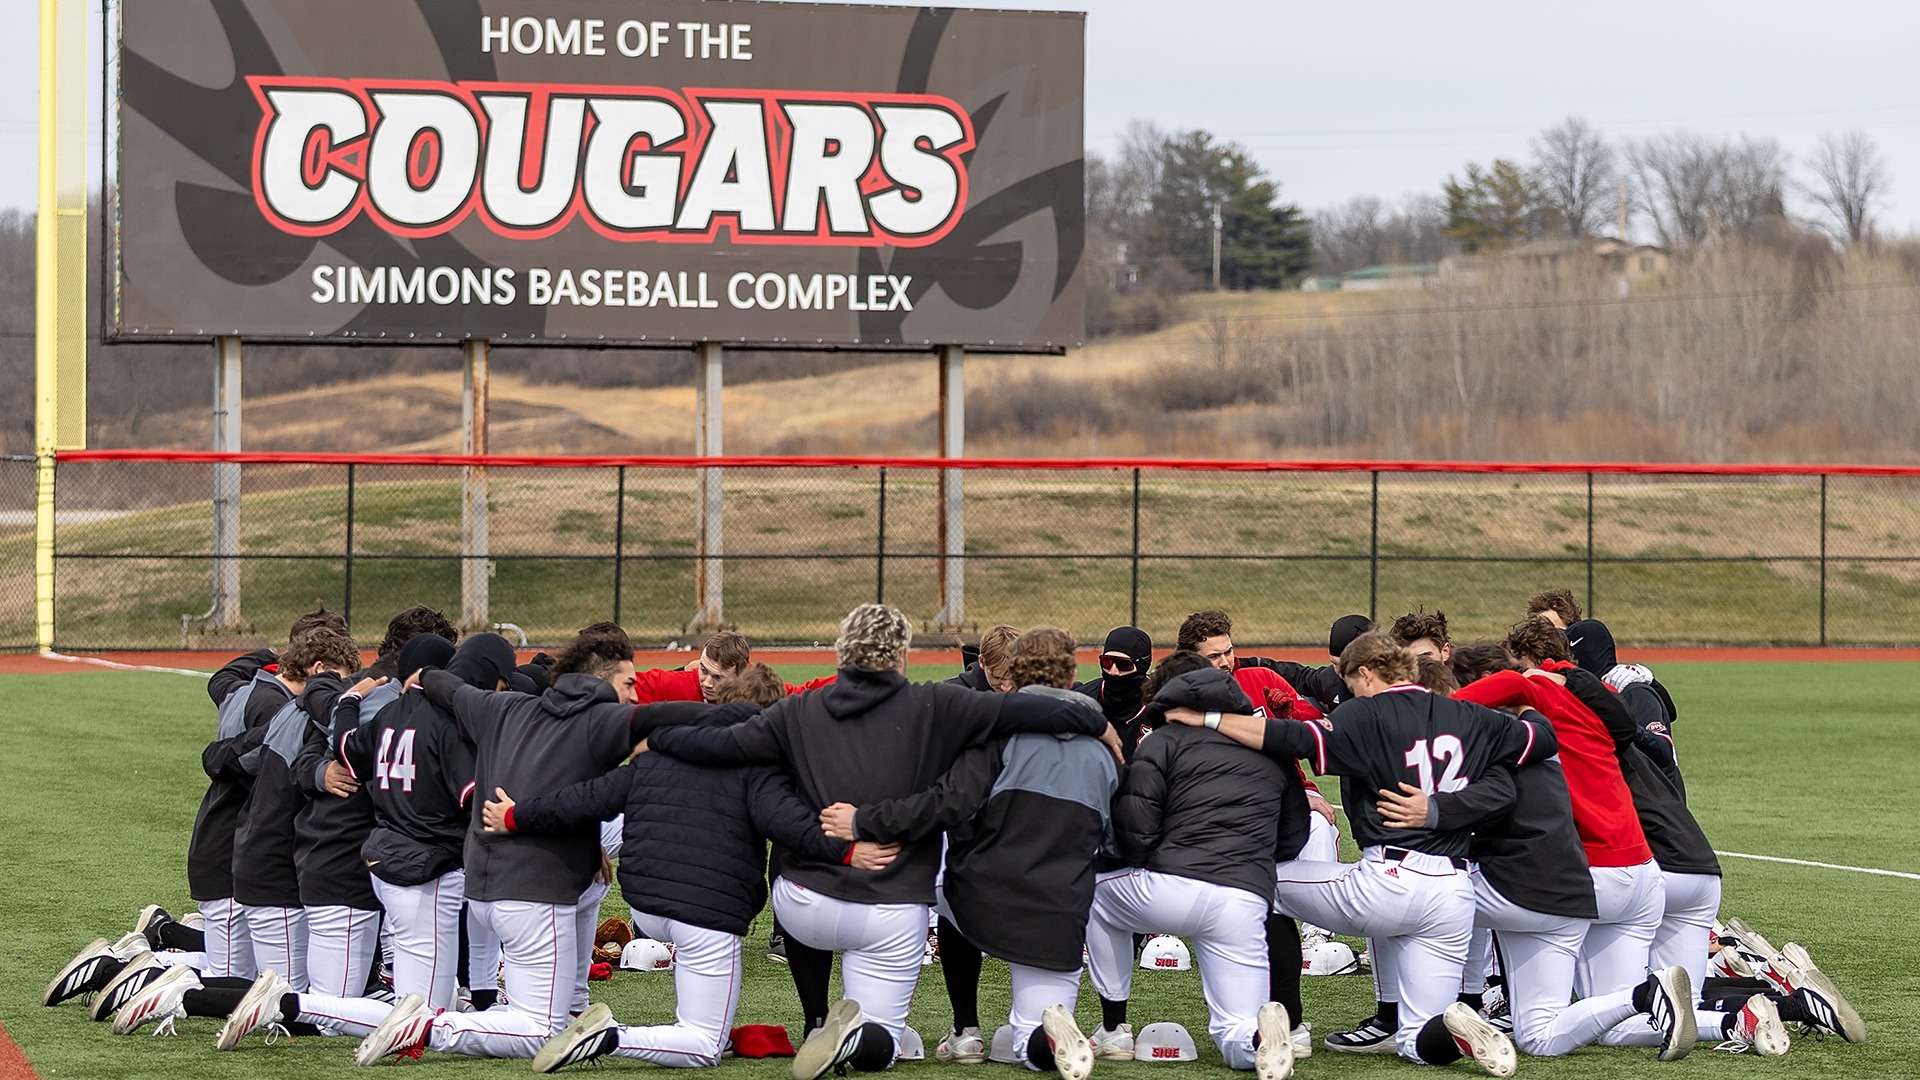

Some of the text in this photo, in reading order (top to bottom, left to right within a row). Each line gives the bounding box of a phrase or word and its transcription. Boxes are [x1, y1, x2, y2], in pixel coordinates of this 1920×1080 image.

[481, 16, 753, 60] HOME OF THE
[257, 84, 969, 238] COUGARS
[310, 264, 914, 312] SIMMONS BASEBALL COMPLEX
[376, 726, 416, 793] 44
[1404, 733, 1470, 797] 12
[1155, 958, 1178, 967] SIUE
[1152, 1047, 1179, 1058] SIUE
